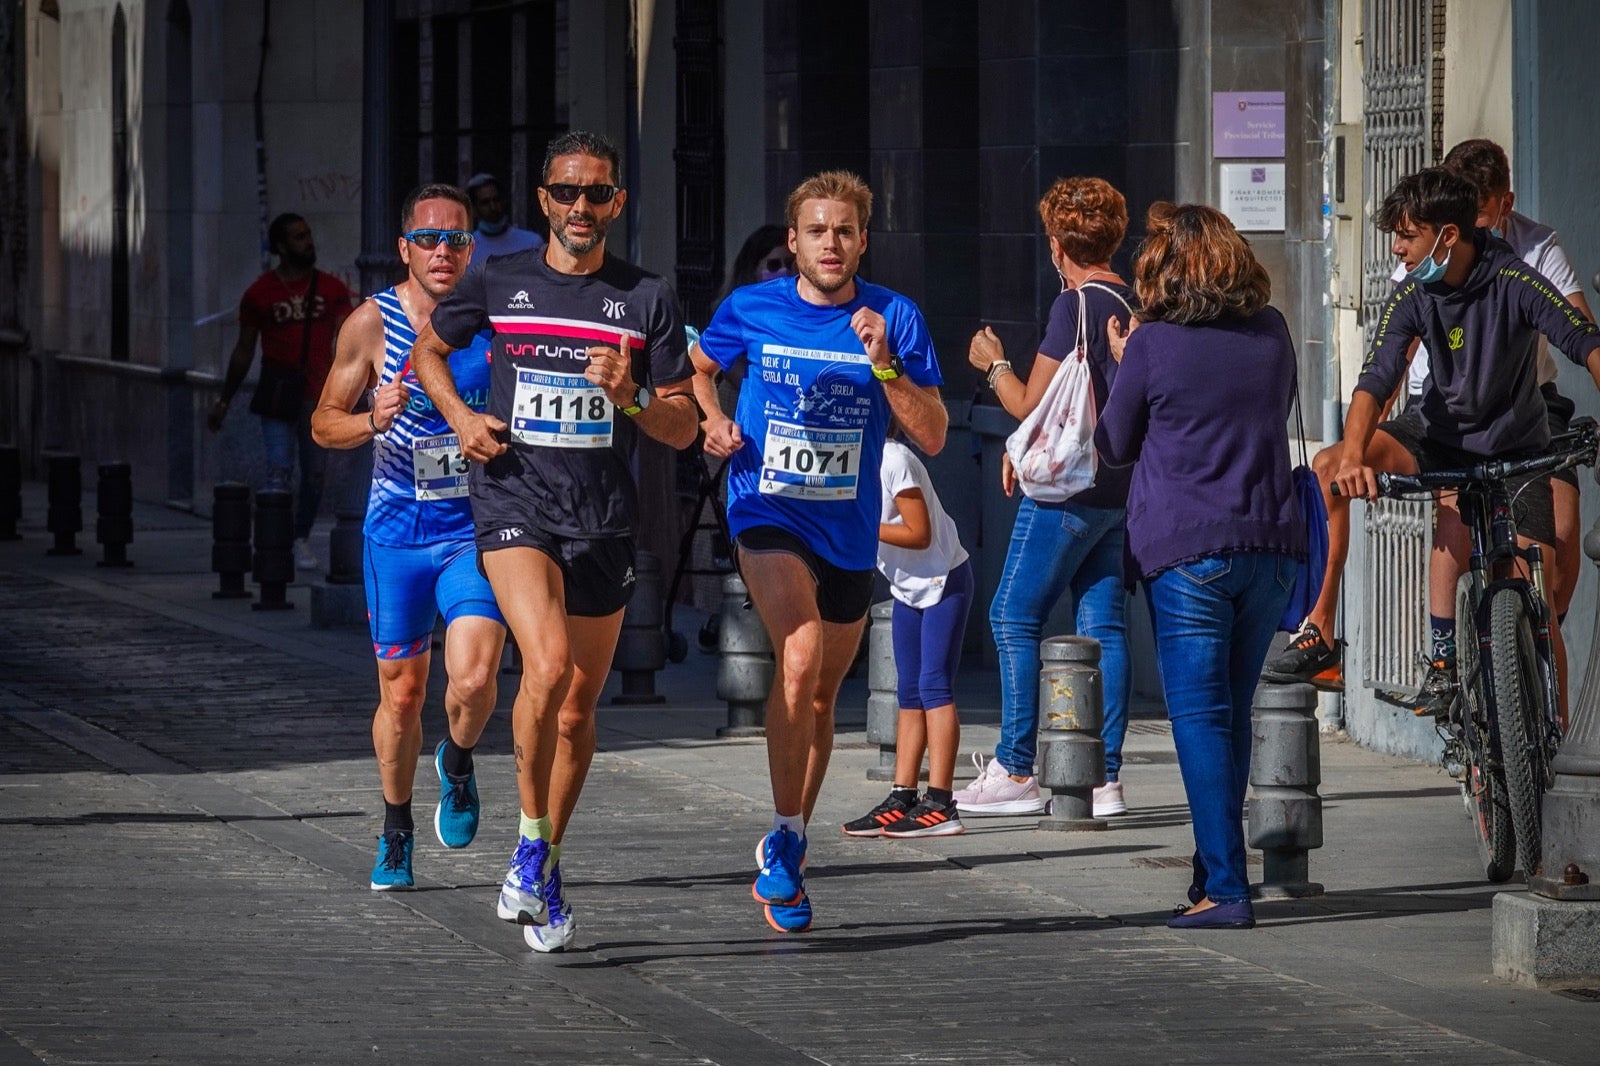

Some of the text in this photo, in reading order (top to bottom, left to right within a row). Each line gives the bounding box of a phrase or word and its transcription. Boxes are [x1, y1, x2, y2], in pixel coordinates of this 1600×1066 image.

[1531, 280, 1564, 308] ILLUSIVE
[506, 343, 593, 361] runrund
[782, 358, 791, 370] LA
[531, 374, 551, 383] CARRERA
[553, 376, 566, 386] AZUL
[568, 378, 578, 386] POR
[785, 373, 800, 386] AZUL
[530, 393, 605, 420] 1118
[560, 422, 577, 434] MOMO
[448, 436, 458, 445] AZU
[816, 432, 826, 440] POR
[836, 433, 856, 441] AUTISMO
[437, 453, 470, 476] 13
[780, 446, 849, 474] 1071
